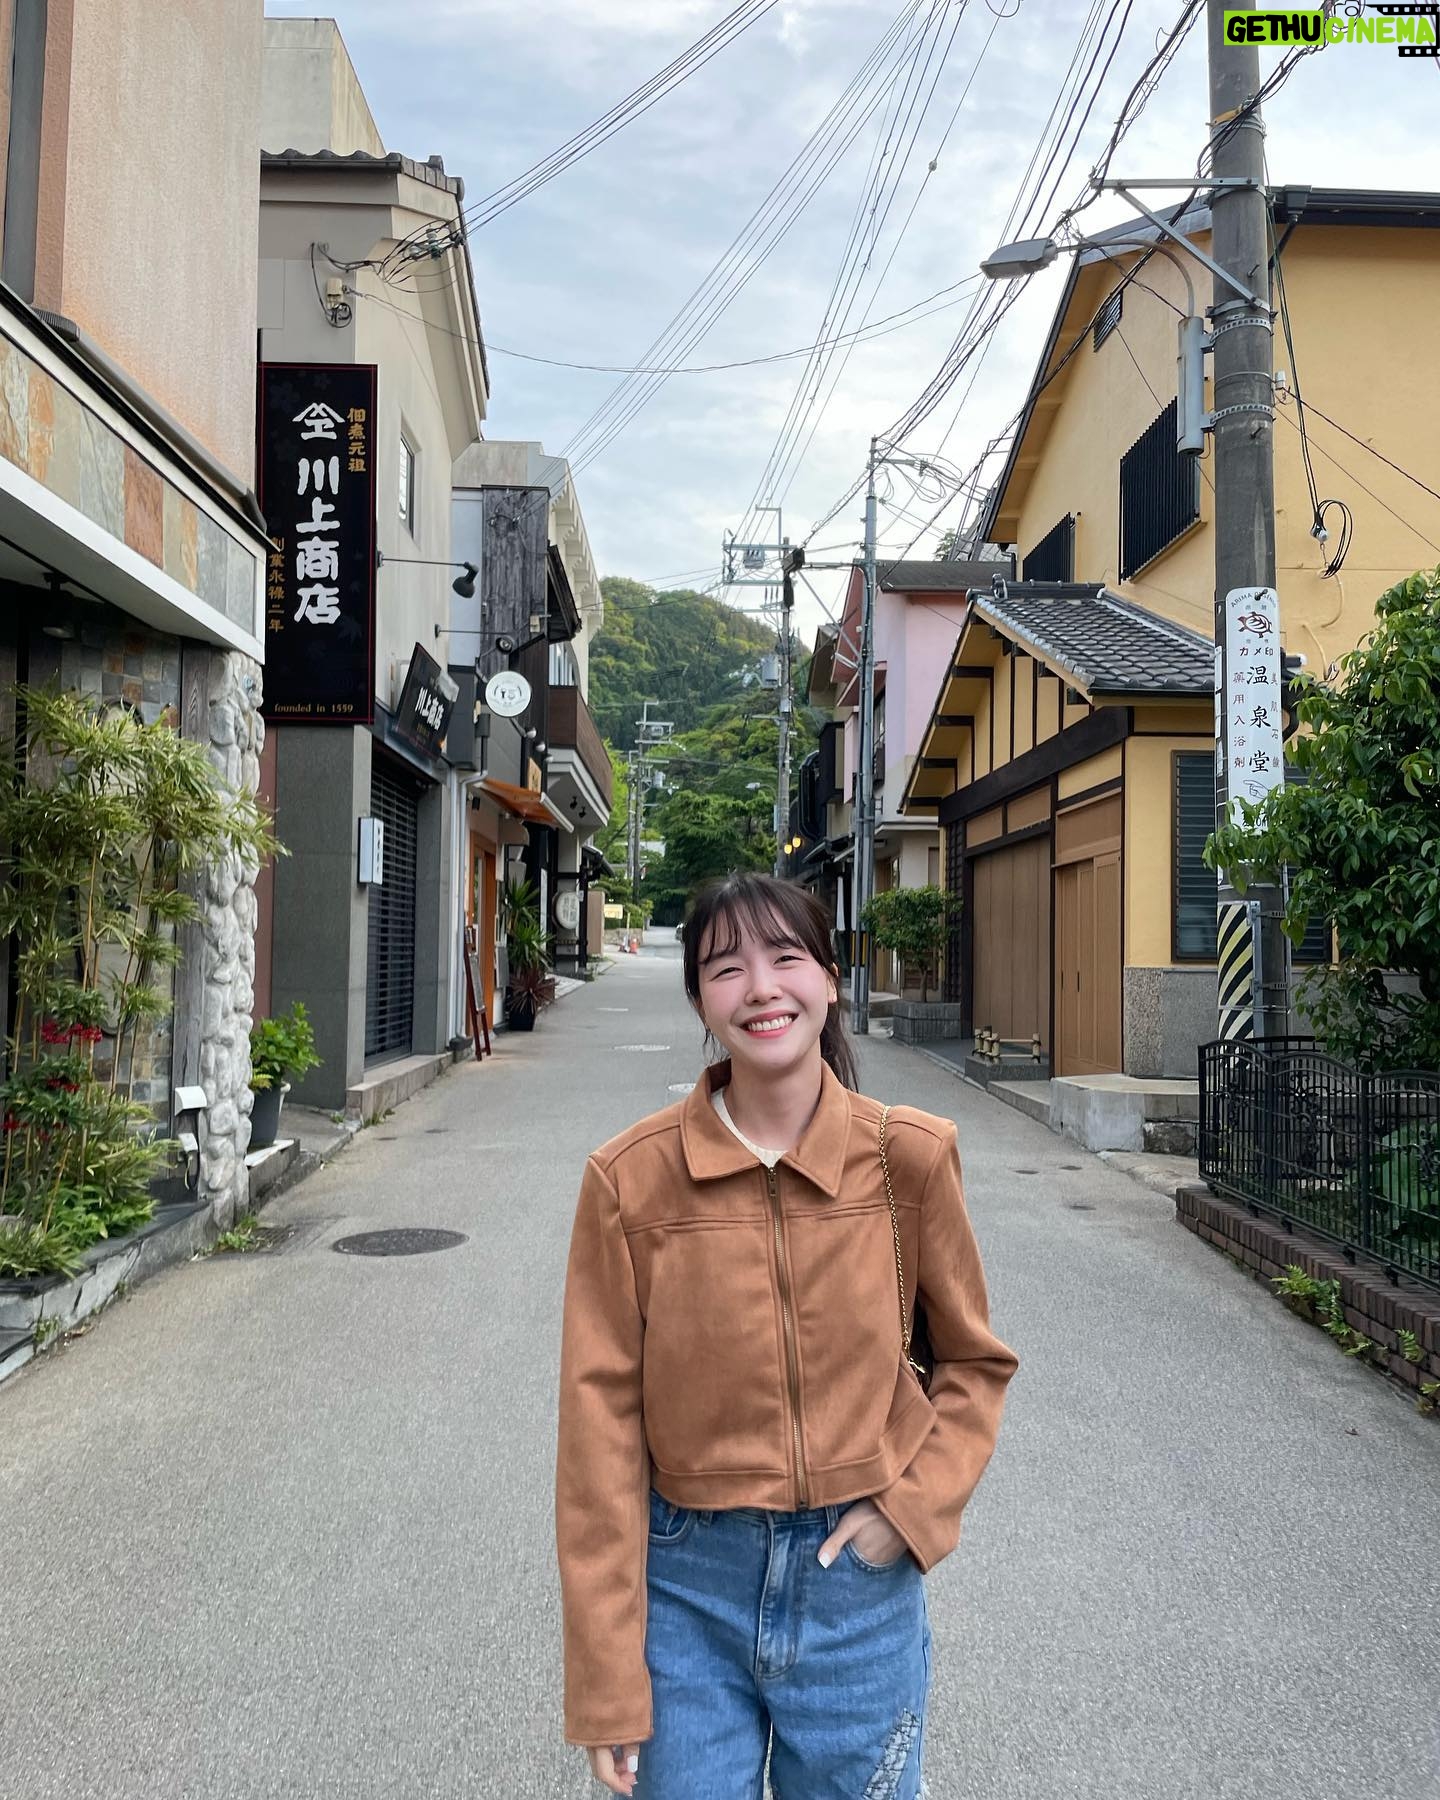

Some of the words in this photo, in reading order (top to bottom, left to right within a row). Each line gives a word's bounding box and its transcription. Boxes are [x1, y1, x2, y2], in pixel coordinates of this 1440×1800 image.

[346, 407, 367, 473] 佃煮元祖
[293, 455, 342, 625] 川上商店
[1230, 592, 1253, 608] ARIMA
[1239, 646, 1274, 657] カメ印
[273, 703, 312, 713] founded
[316, 703, 326, 713] in
[331, 703, 354, 713] 1559
[414, 686, 444, 731] 川上商店
[1246, 664, 1272, 774] 温泉堂
